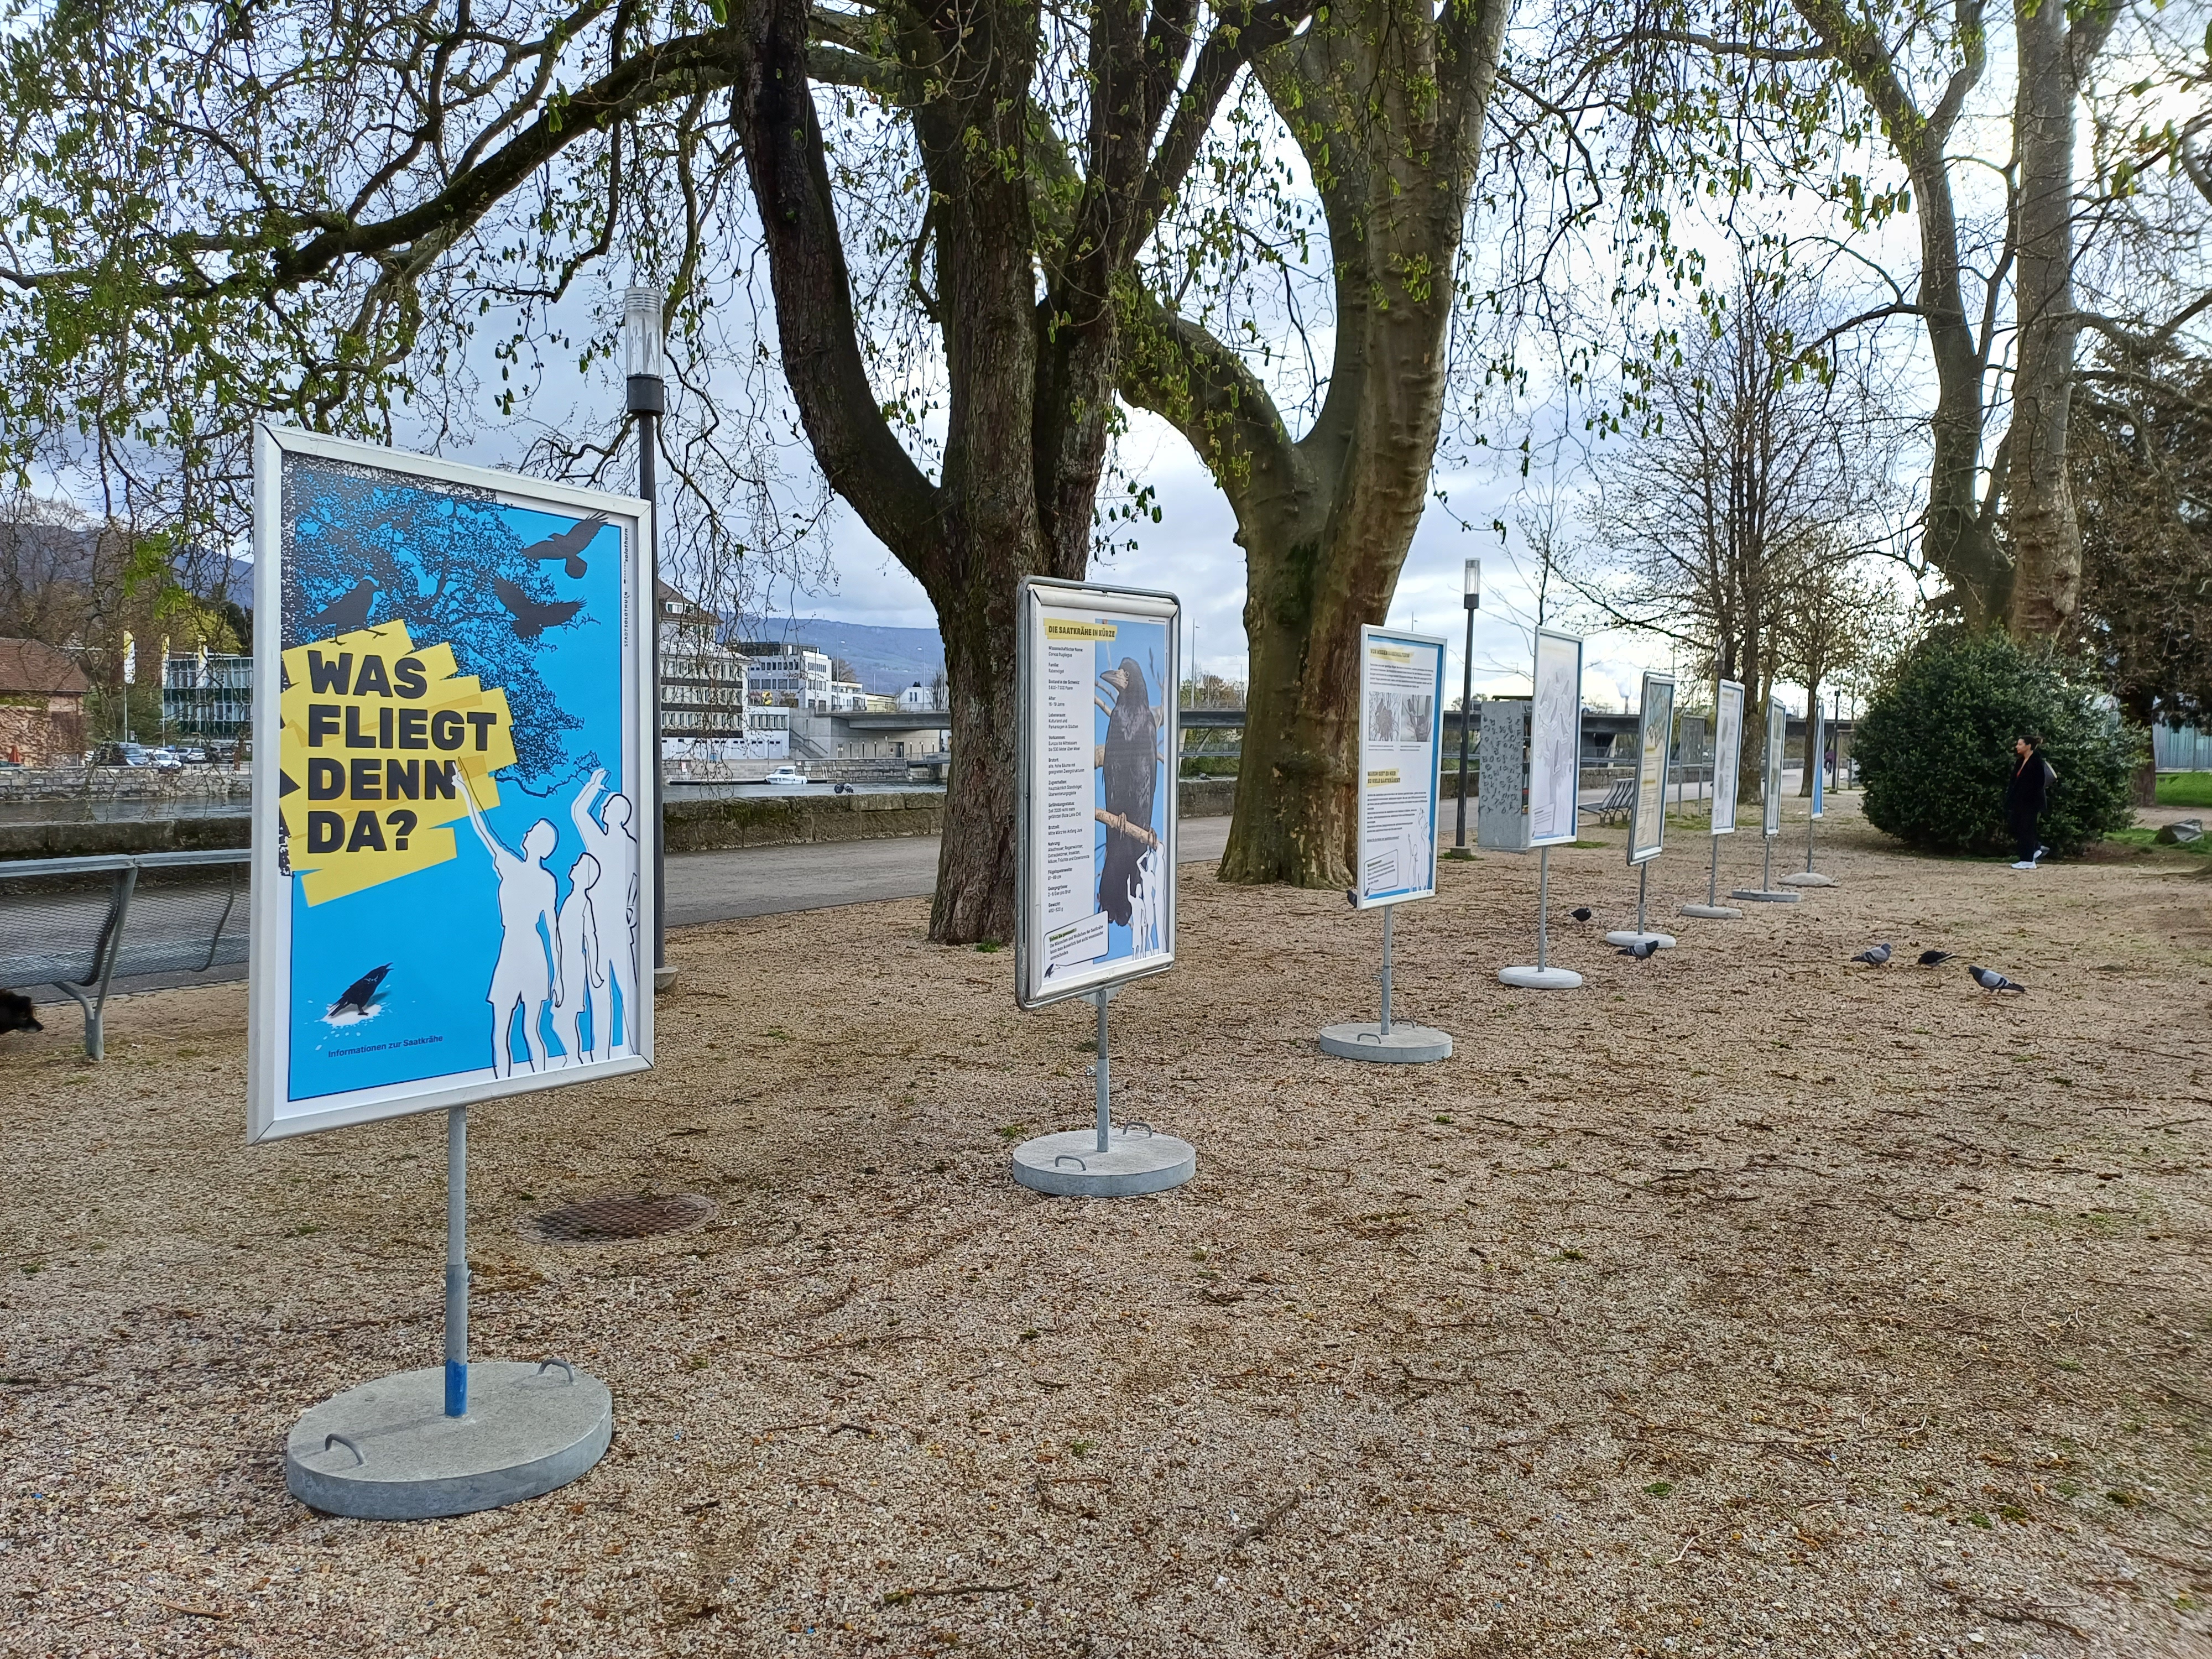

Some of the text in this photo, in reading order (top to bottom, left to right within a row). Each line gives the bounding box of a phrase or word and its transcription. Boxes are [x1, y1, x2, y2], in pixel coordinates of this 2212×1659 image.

[1059, 626, 1092, 635] SAATKRÄHE
[1099, 628, 1115, 637] KÜRZE
[308, 650, 427, 699] WAS
[307, 704, 497, 751] FLIEGT
[308, 758, 456, 800] DENN
[308, 810, 417, 854] DA?
[328, 1045, 386, 1057] Informationen
[403, 1035, 443, 1046] Saatkrähe
